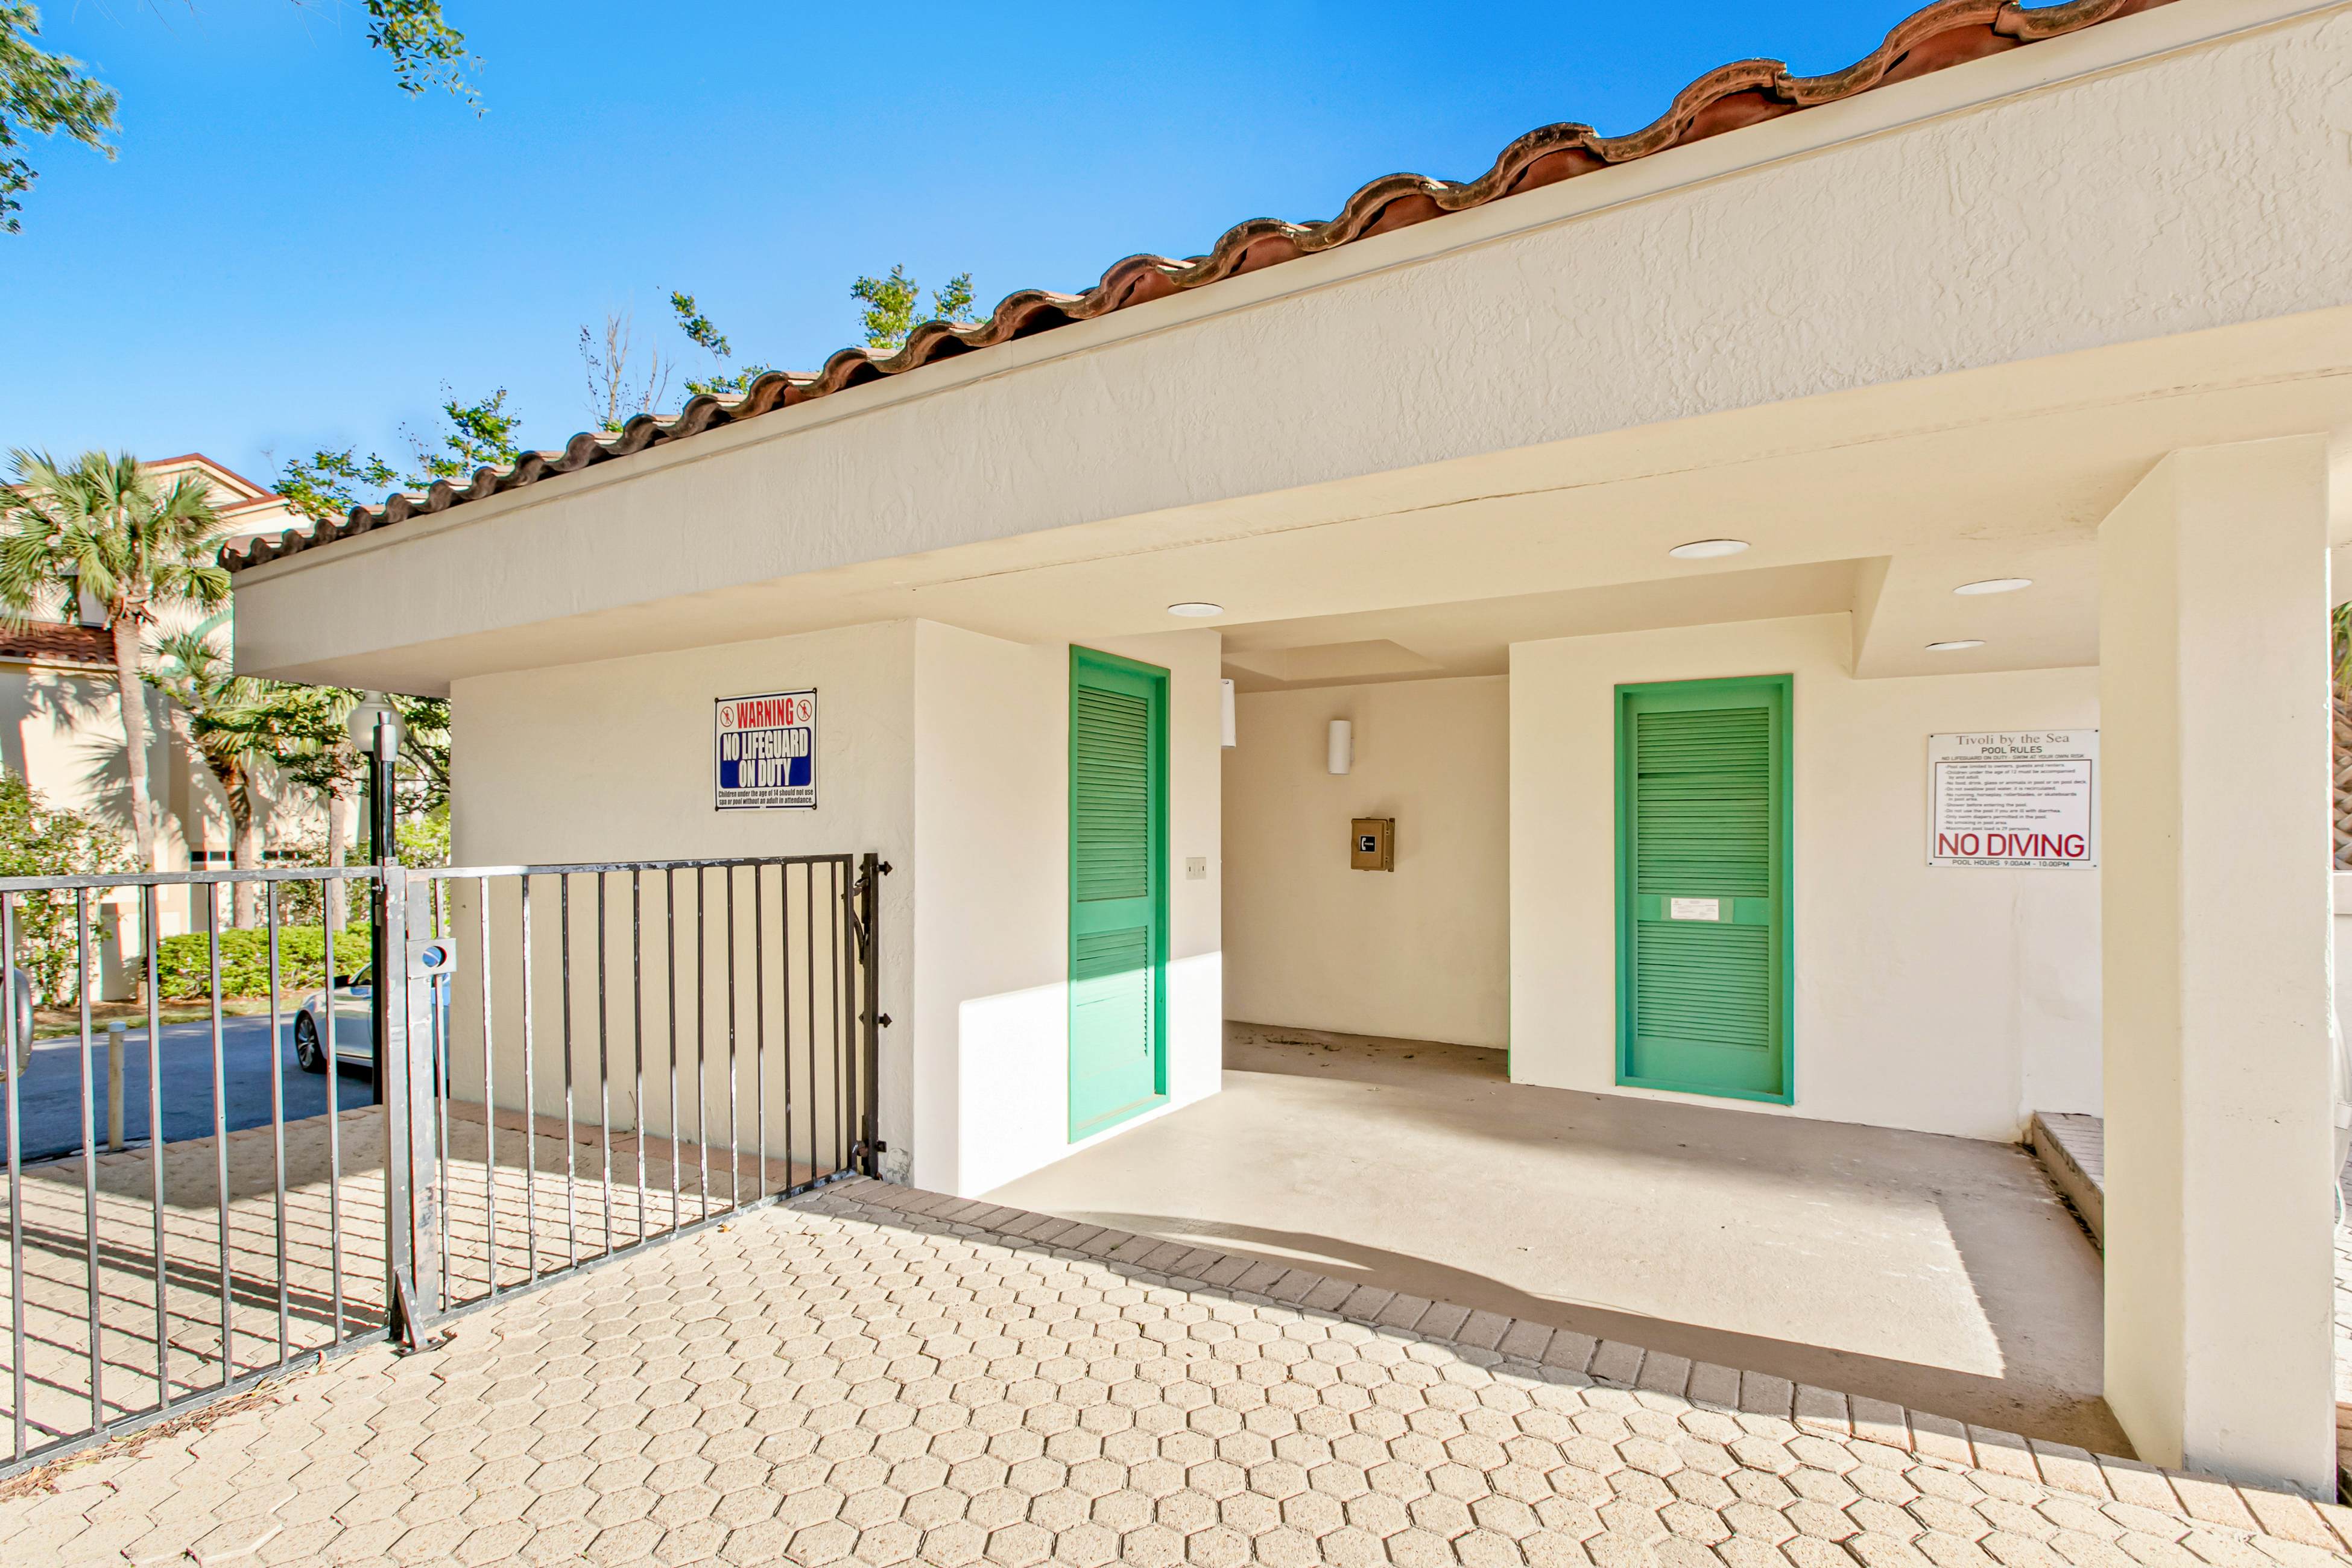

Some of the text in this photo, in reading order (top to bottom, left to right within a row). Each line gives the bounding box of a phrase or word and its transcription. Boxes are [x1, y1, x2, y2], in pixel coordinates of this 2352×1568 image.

[736, 698, 794, 729] WARNING
[724, 728, 808, 762] NO LIFEGUARD
[1956, 733, 2070, 746] Tivoli by the Sea
[739, 758, 791, 788] ON DUTY
[1939, 833, 2085, 858] NO DIVING
